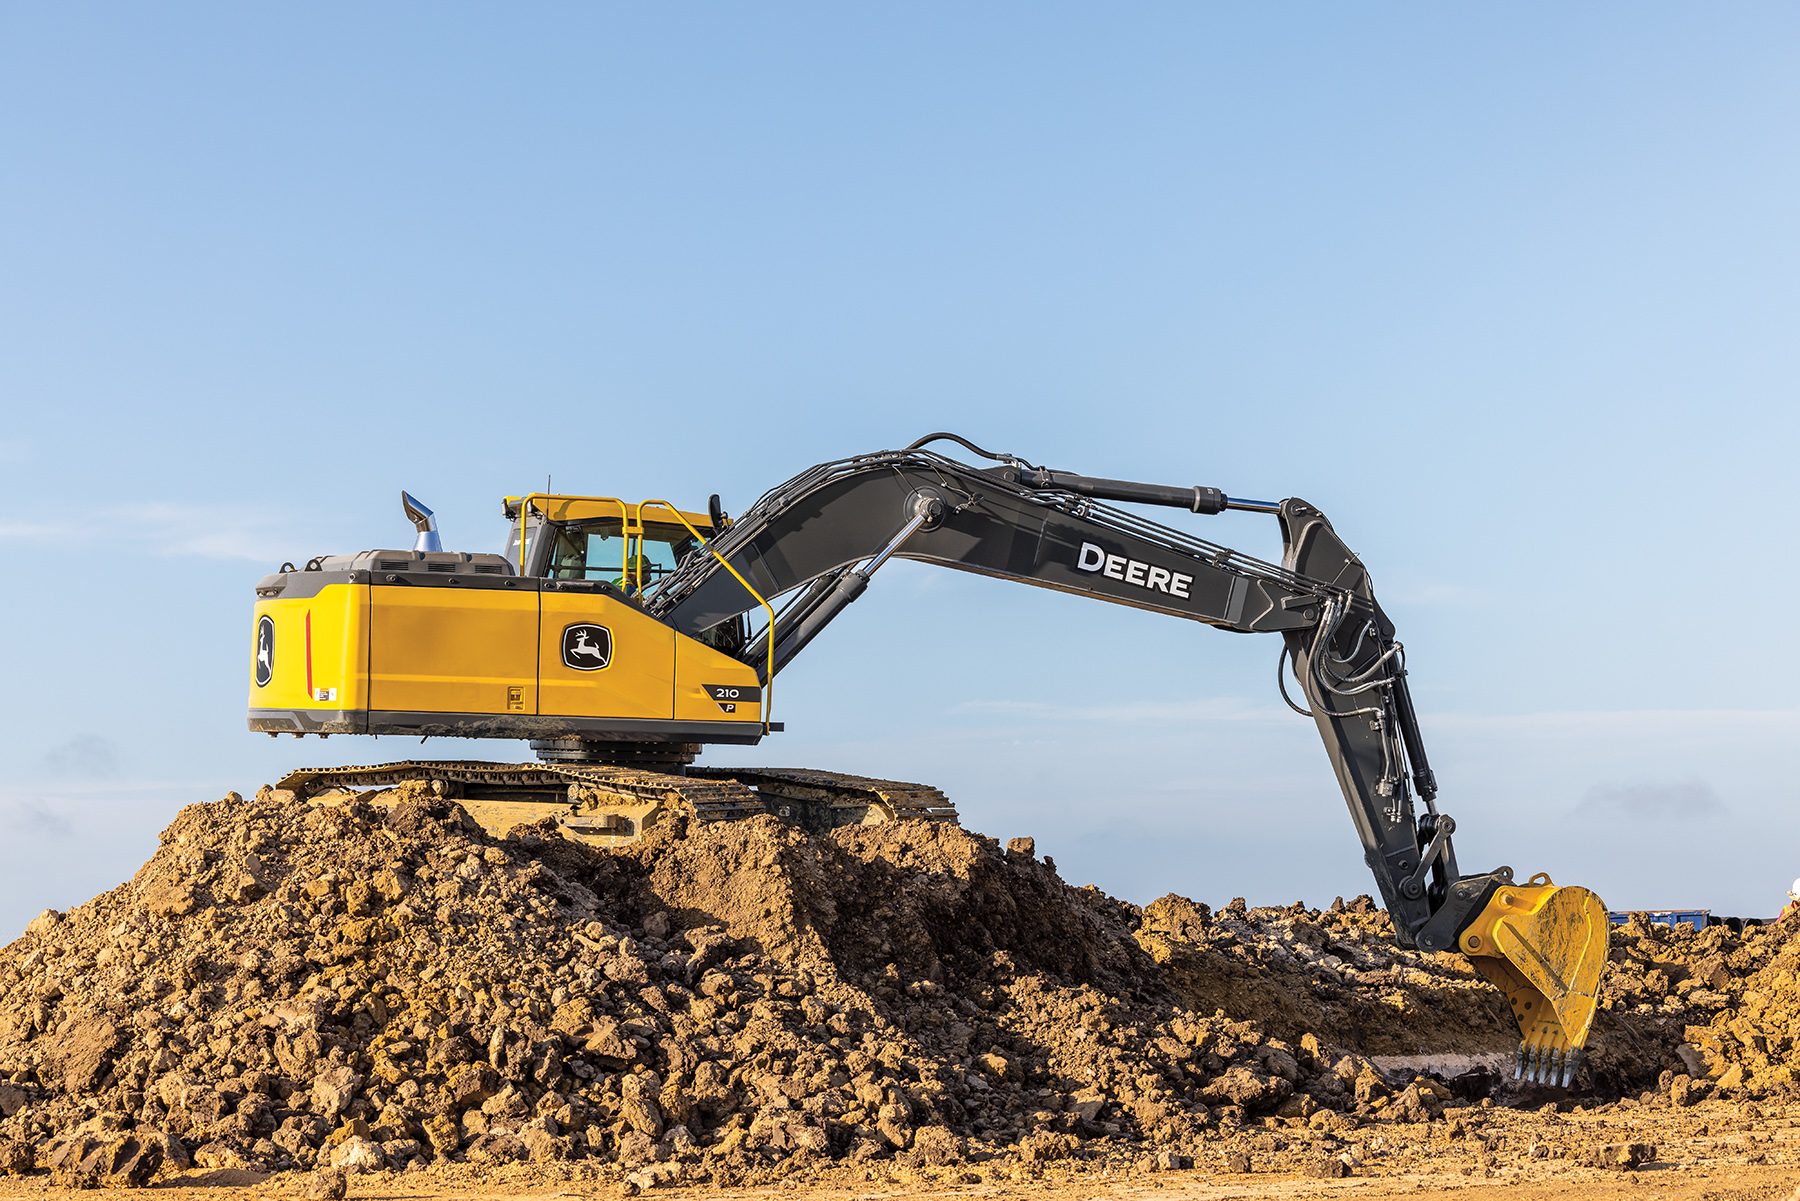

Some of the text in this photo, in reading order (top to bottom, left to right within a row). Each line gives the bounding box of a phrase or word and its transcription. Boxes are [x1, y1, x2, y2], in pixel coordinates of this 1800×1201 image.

[1077, 541, 1193, 599] DEERE
[716, 688, 740, 699] 210
[725, 704, 735, 712] P
